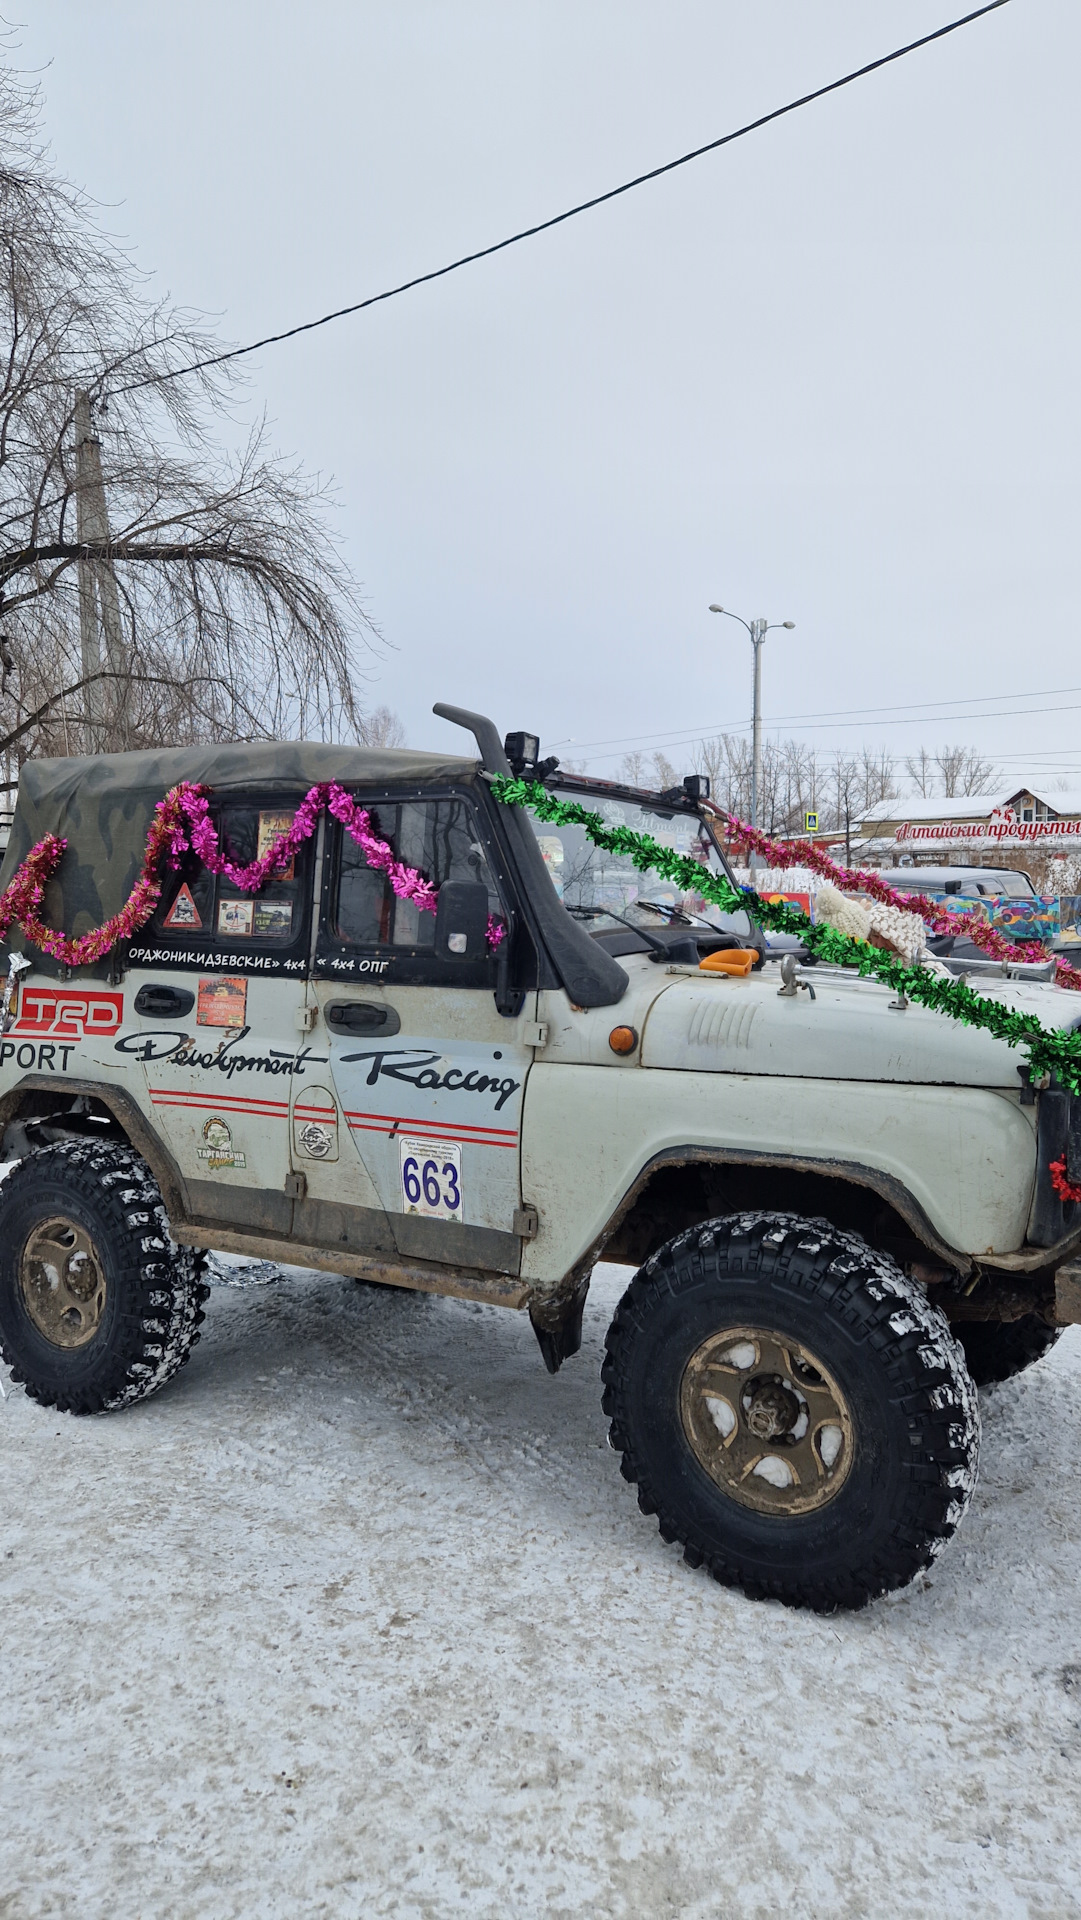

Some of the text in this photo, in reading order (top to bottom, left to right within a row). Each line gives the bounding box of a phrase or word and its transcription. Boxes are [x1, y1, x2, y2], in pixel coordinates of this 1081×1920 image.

[896, 820, 1081, 841] Алтайские продукты
[359, 959, 389, 973] ОПГ
[26, 997, 119, 1033] TRD
[114, 1026, 520, 1111] Development Racing
[403, 1157, 460, 1210] 663
